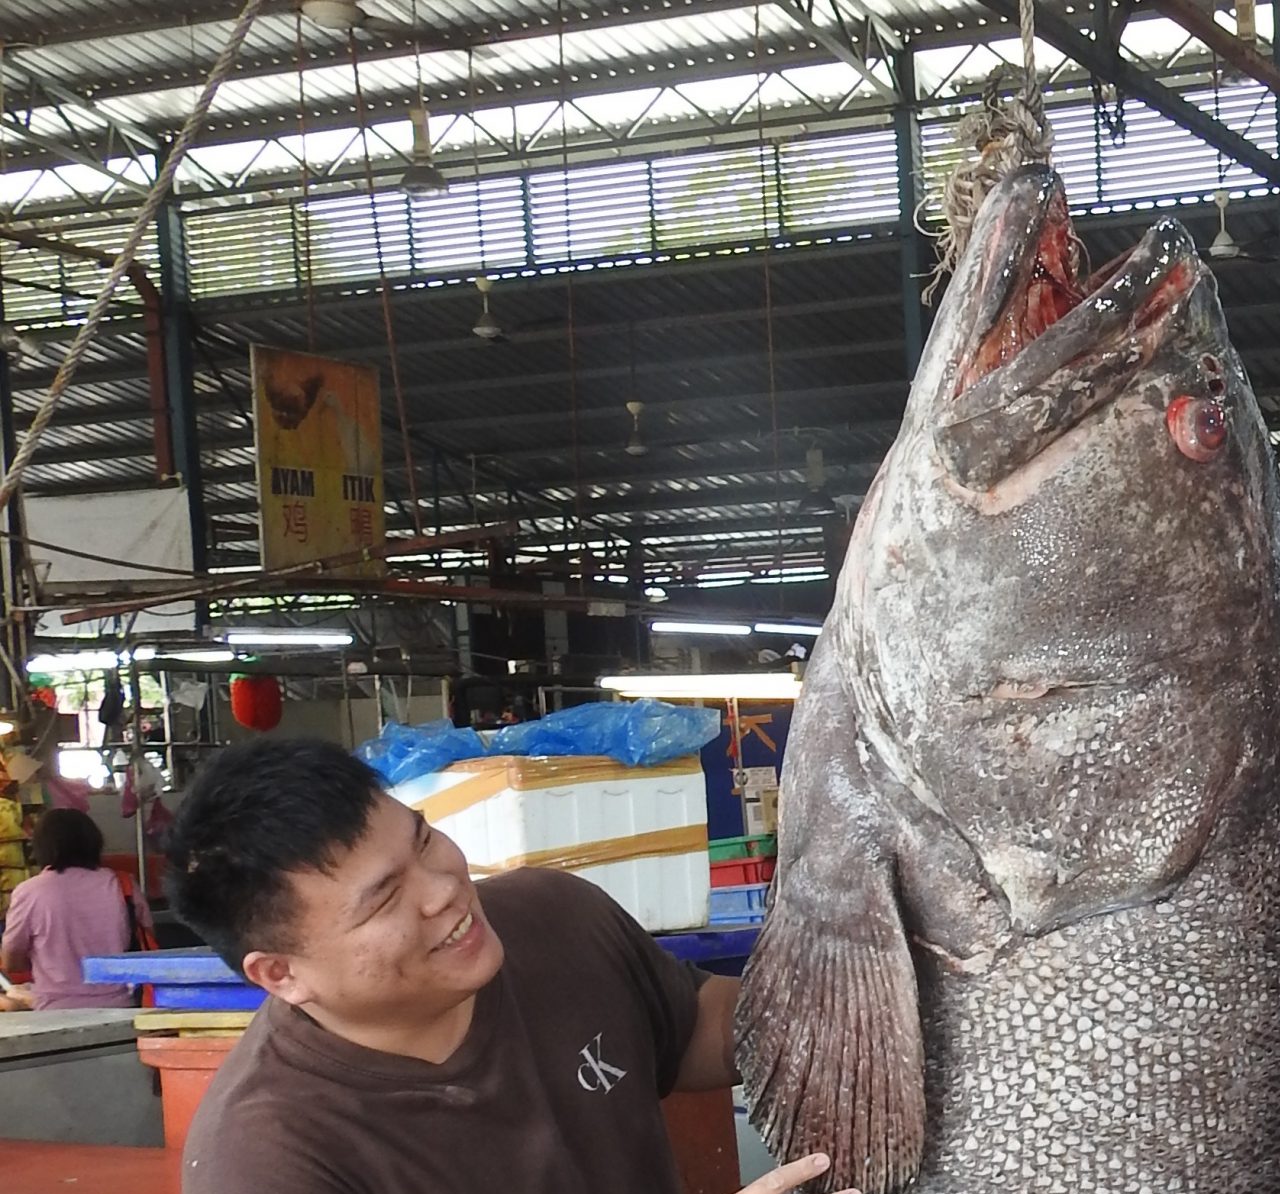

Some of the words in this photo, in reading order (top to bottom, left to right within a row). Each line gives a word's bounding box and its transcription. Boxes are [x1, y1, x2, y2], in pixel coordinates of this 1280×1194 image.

[271, 467, 315, 497] AYAM
[342, 474, 375, 502] ITIK
[282, 500, 308, 543] 鸡
